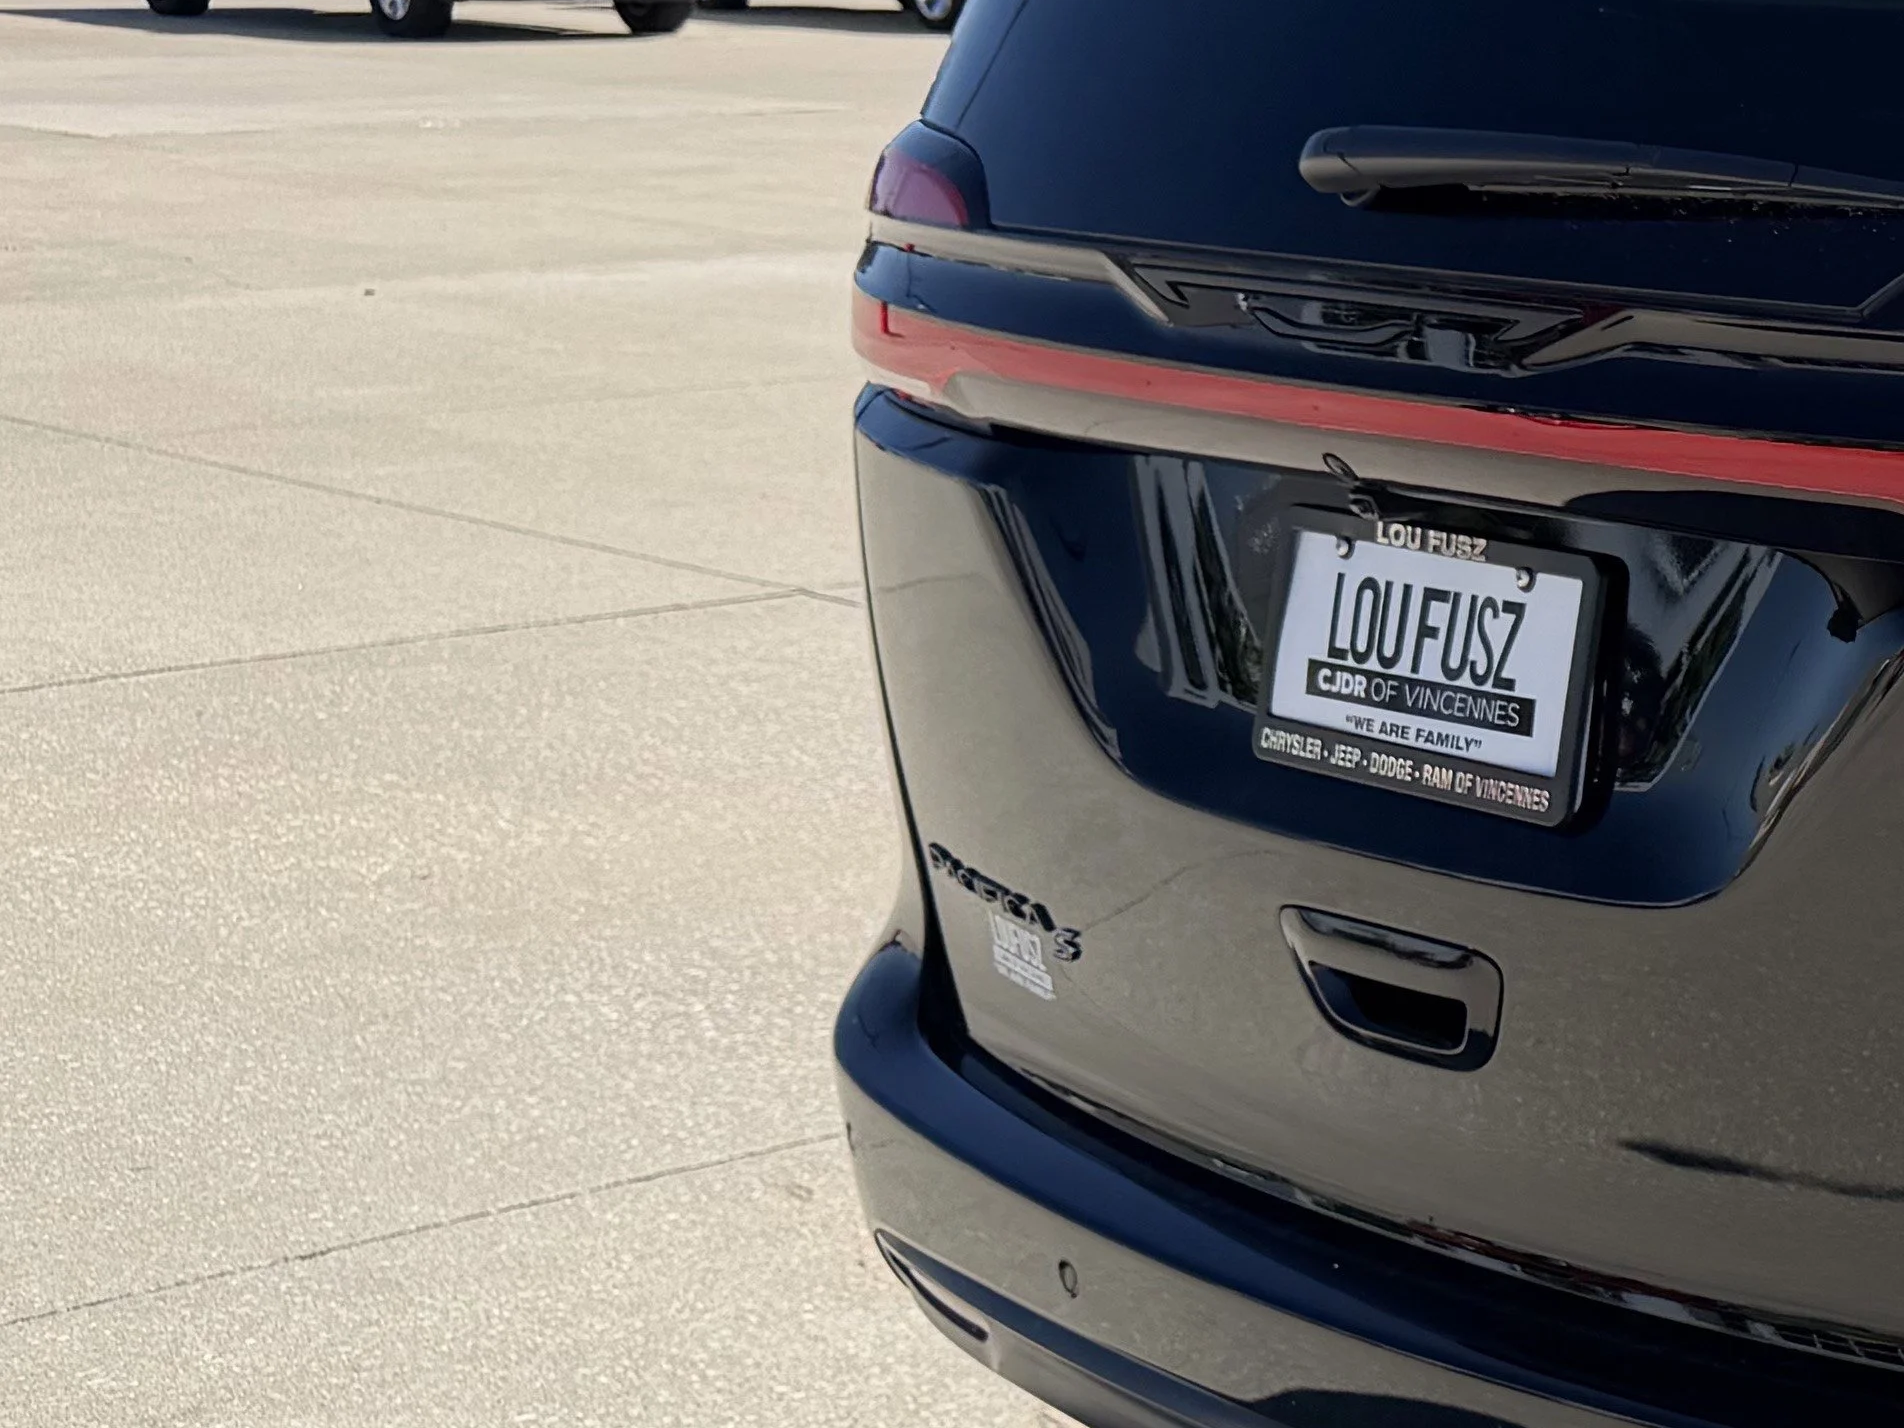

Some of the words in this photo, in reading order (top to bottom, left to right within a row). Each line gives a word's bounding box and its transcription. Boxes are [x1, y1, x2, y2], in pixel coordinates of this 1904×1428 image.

[1375, 521, 1421, 551] LOU
[1427, 528, 1488, 562] FUSZ
[1327, 571, 1414, 670] LOU
[1410, 586, 1528, 693] FUSZ
[1317, 667, 1367, 699] CJDR
[1371, 677, 1400, 704] OF
[1404, 683, 1521, 728] VINCENNES
[1378, 721, 1411, 742] ARE
[1260, 726, 1323, 761] CHRYSLER
[1330, 743, 1362, 770] JEEP
[1369, 752, 1413, 783] DODGE
[1421, 763, 1454, 791] RAM
[1455, 771, 1476, 796] OF
[1476, 775, 1552, 814] VINCENNES
